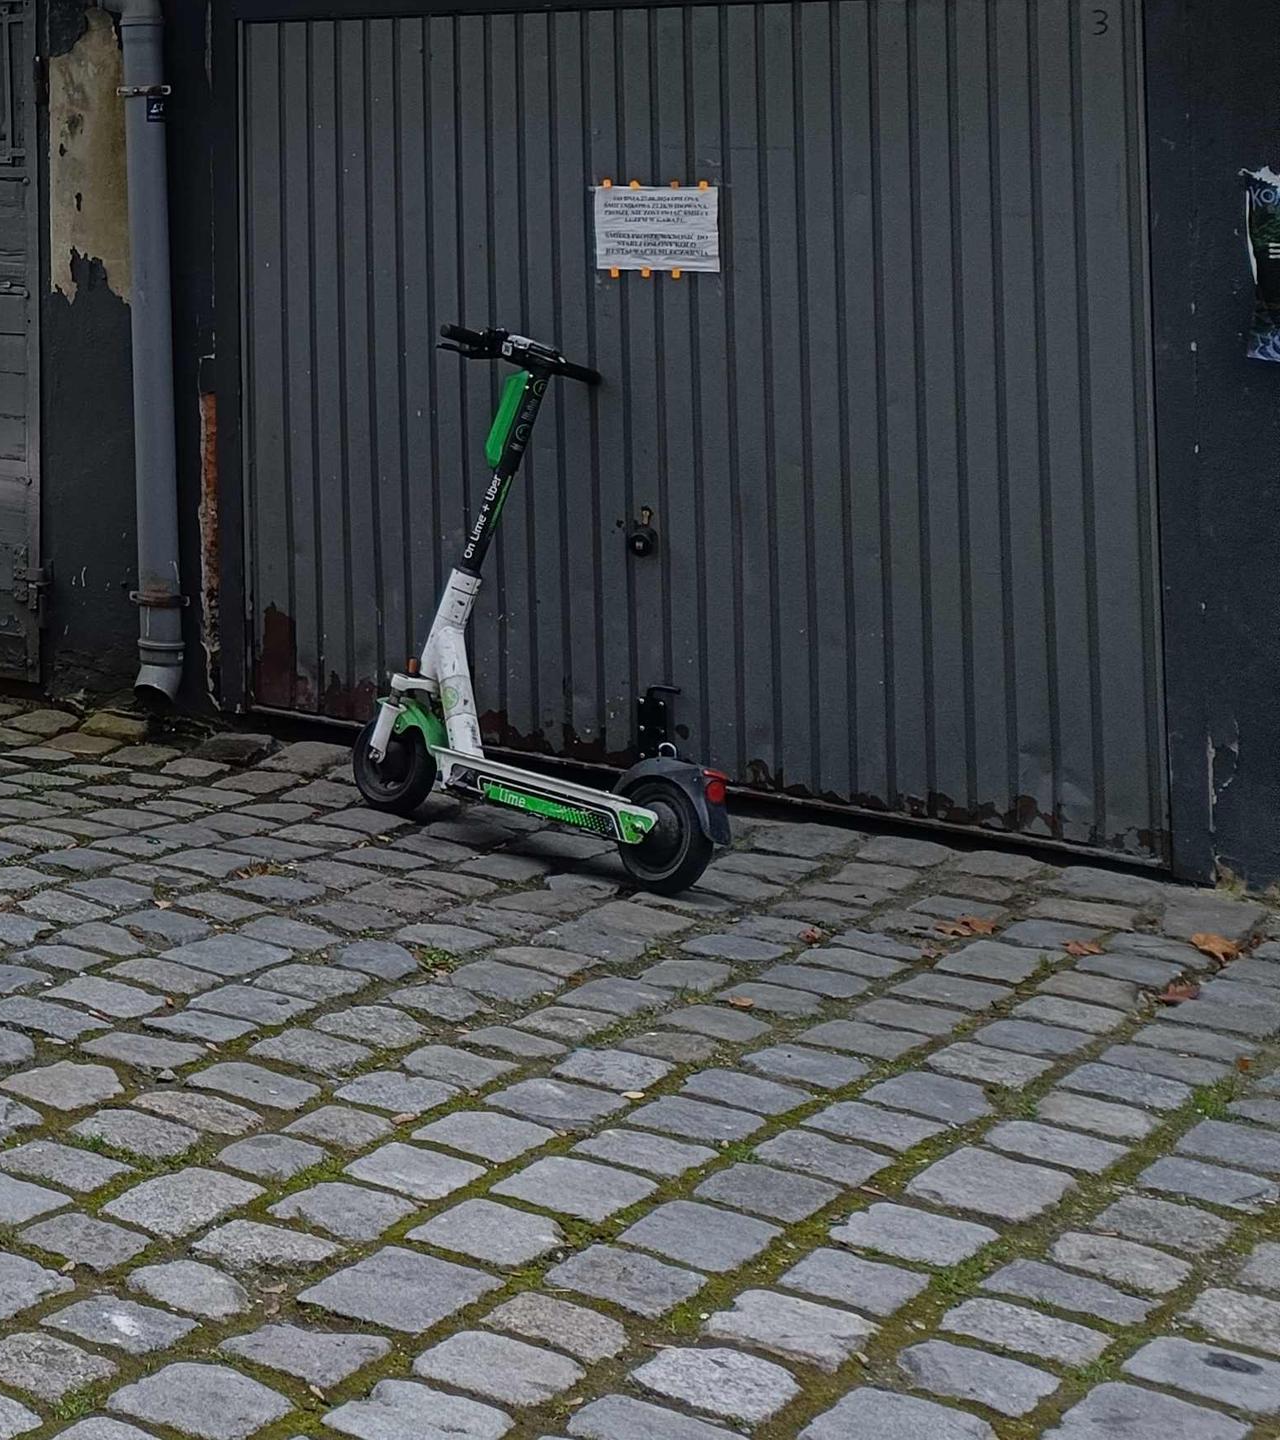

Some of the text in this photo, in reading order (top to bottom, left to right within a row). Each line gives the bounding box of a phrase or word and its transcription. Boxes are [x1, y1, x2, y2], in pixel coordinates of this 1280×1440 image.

[1091, 9, 1109, 36] 3
[1249, 185, 1280, 210] KO
[464, 542, 476, 559] On
[470, 513, 487, 541] Lime
[485, 474, 501, 501] Uber
